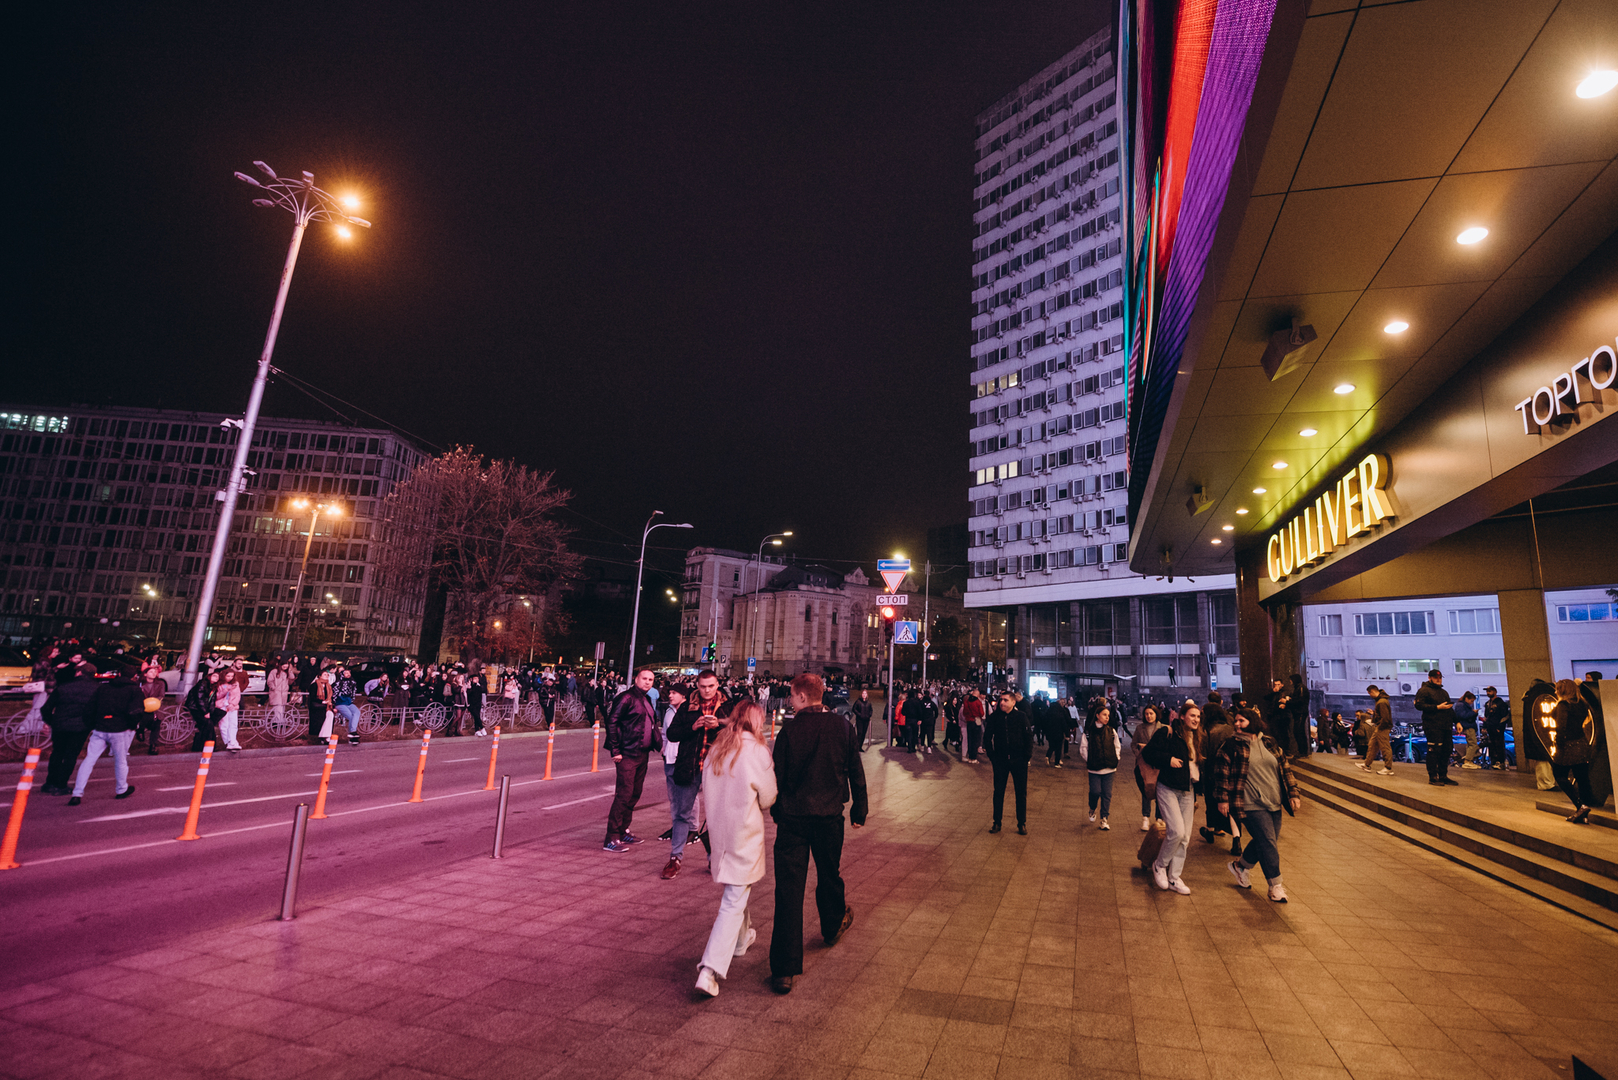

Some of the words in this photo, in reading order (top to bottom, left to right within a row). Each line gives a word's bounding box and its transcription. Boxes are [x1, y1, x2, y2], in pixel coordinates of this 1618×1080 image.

[1514, 335, 1618, 435] ТОРГО
[1266, 453, 1388, 583] GULLIVER
[878, 595, 906, 604] СТОП
